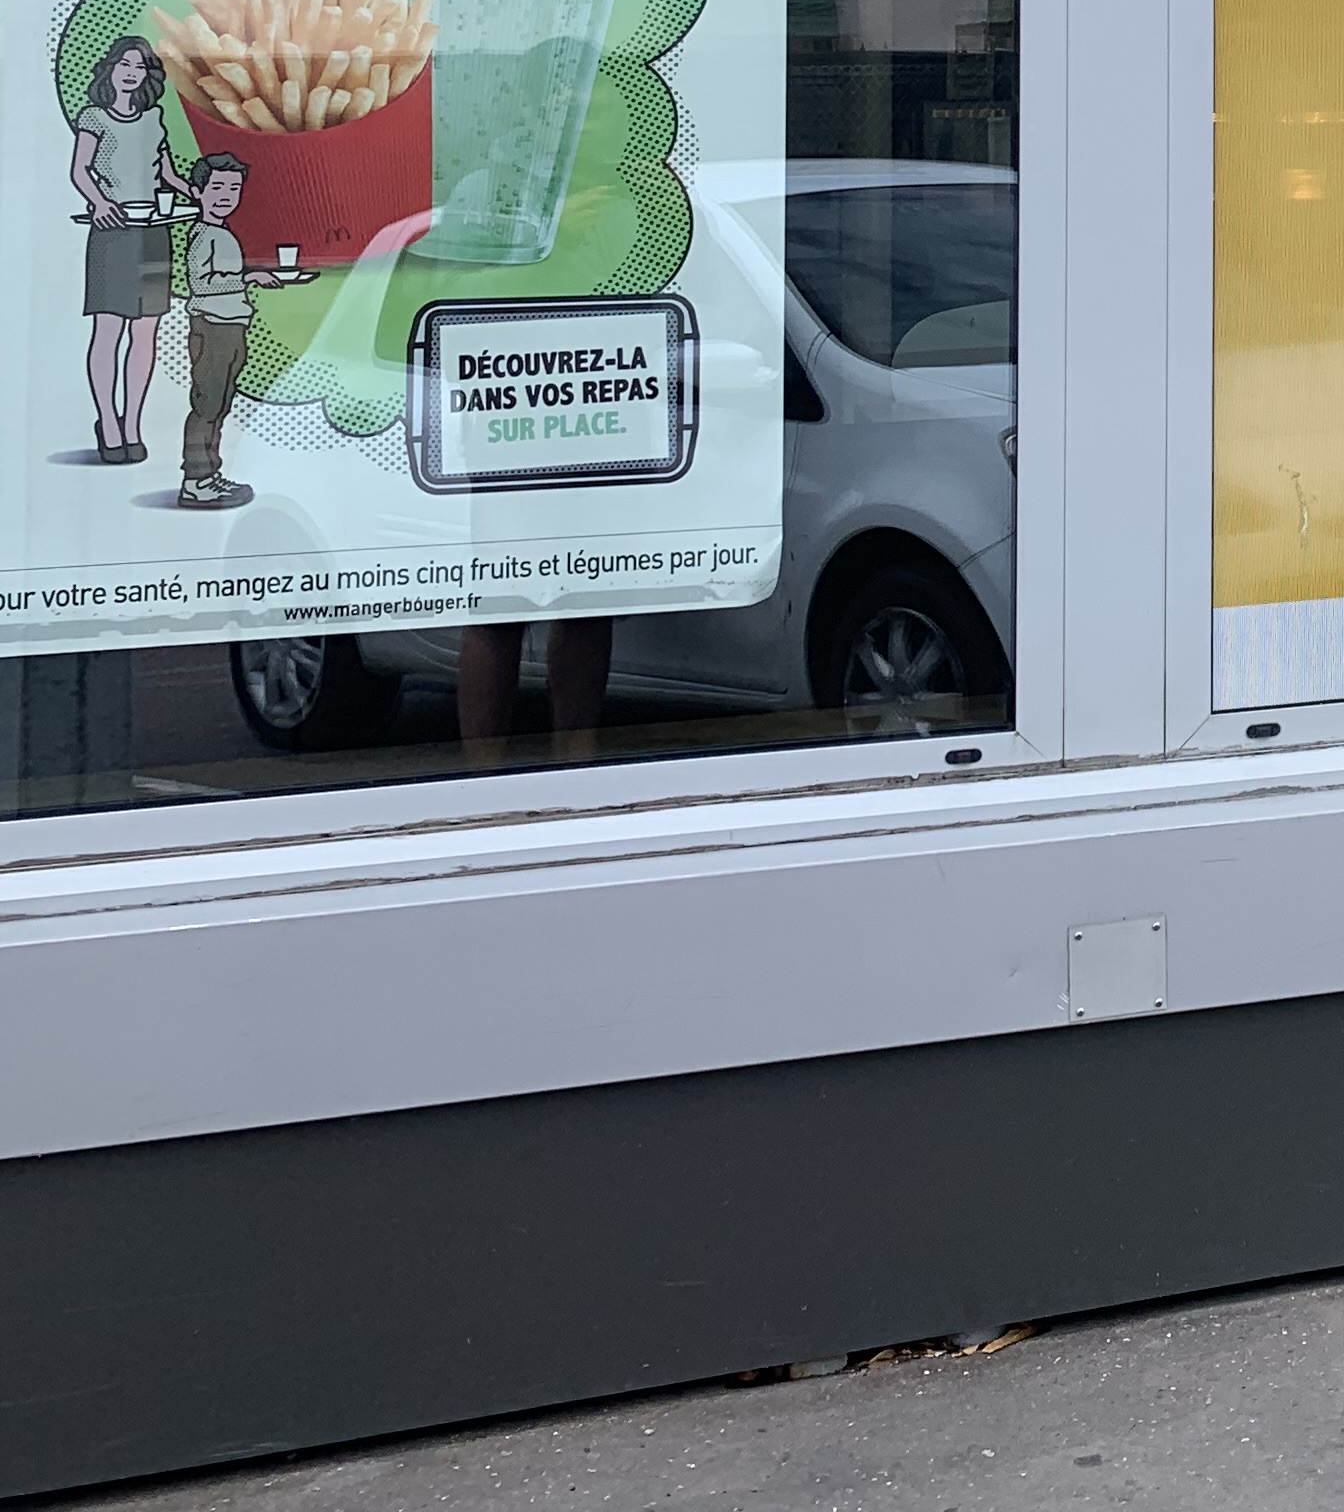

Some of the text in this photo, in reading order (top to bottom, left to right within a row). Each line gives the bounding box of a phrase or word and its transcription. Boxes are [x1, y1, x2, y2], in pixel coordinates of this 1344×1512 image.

[458, 349, 648, 381] DÉCOUVREZ-LA
[450, 376, 659, 413] DANS VOS REPAS
[487, 411, 627, 443] SUR PLACE.
[41, 584, 107, 608] votre
[113, 574, 188, 604] santé,
[196, 575, 294, 601] mangez
[300, 572, 330, 591] au
[337, 564, 409, 589] moins
[416, 560, 464, 587] cinq
[470, 555, 532, 581] fruits
[538, 554, 561, 577] et
[566, 548, 664, 580] légumes
[669, 548, 707, 575] par
[710, 543, 759, 572] jour.
[284, 592, 483, 621] www.mangerbouger.fr
